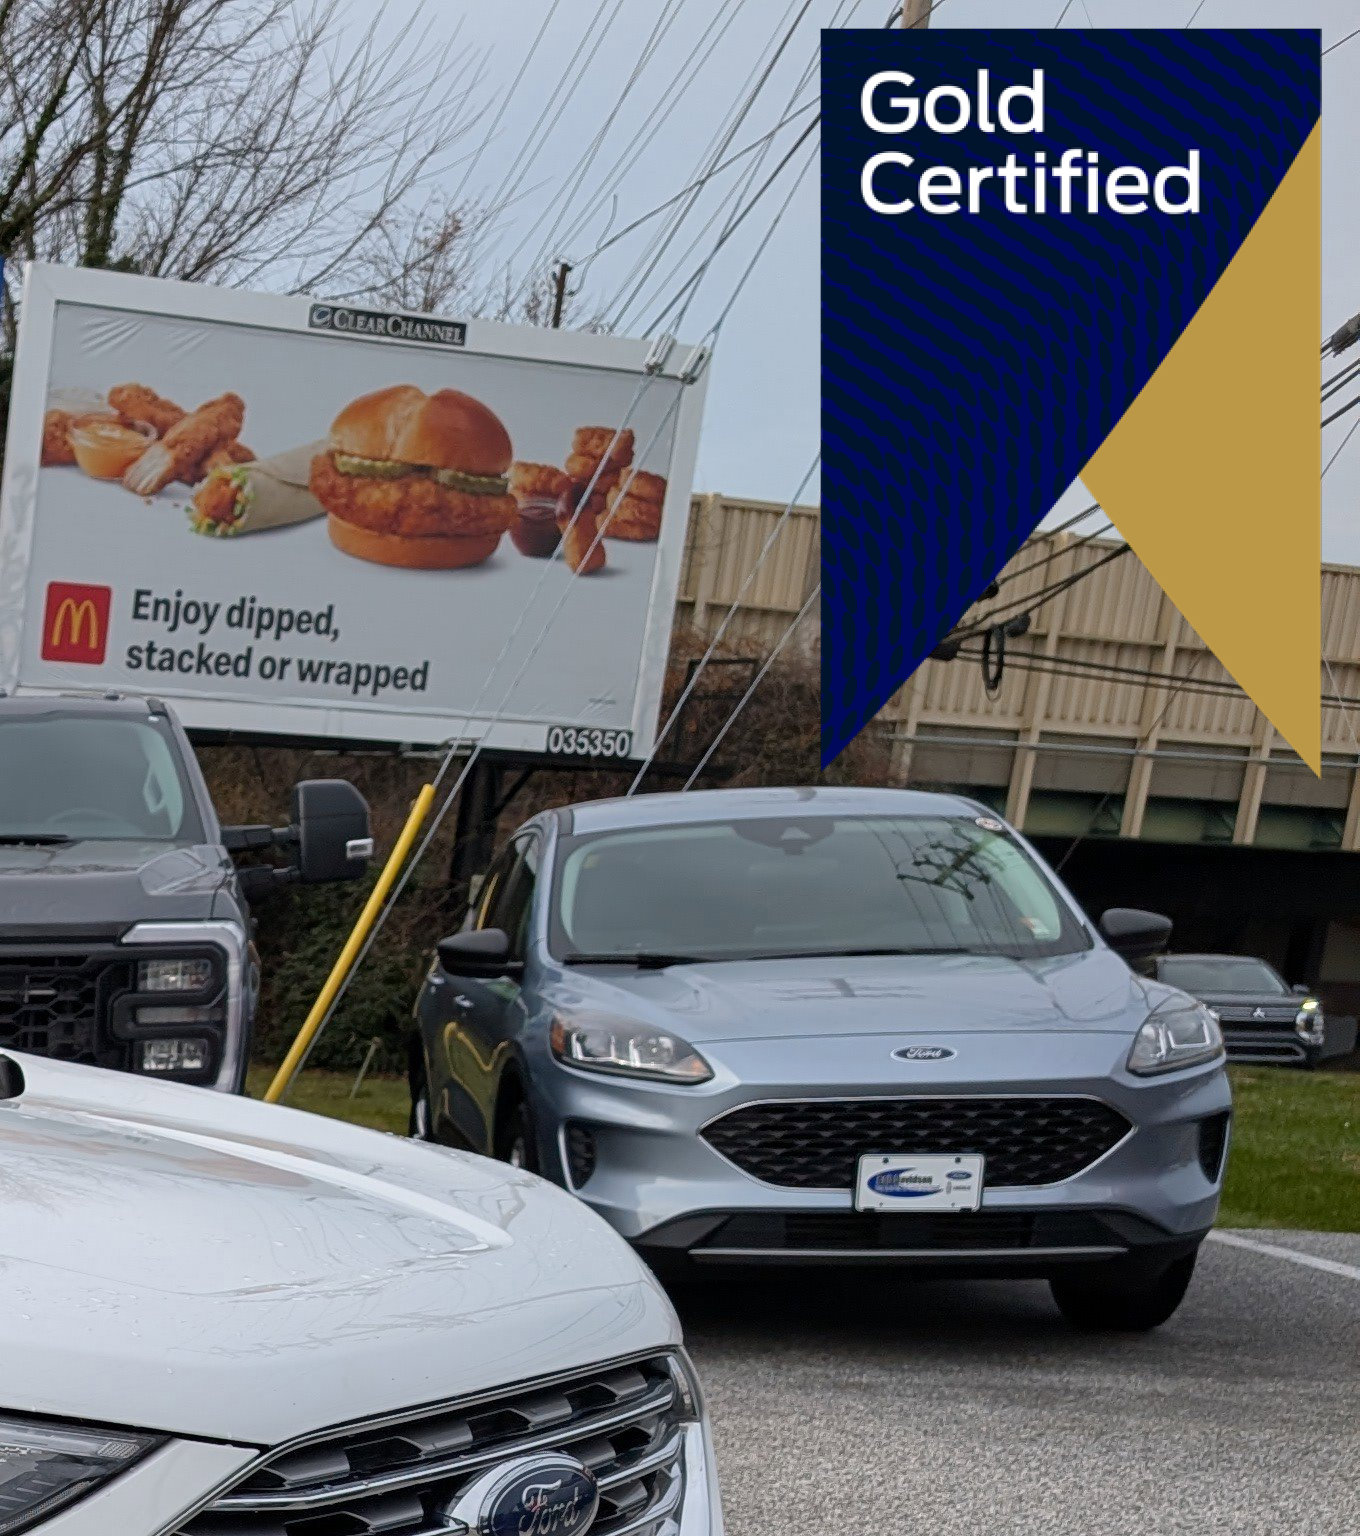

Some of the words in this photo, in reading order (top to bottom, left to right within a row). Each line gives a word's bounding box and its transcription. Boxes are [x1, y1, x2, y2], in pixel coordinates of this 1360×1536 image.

[131, 588, 221, 635] Enjoy
[226, 595, 340, 642] dipped,
[125, 640, 254, 679] stacked
[258, 653, 291, 681] or
[297, 657, 430, 696] wrapped
[548, 726, 631, 758] 035350
[906, 1046, 943, 1059] Ford
